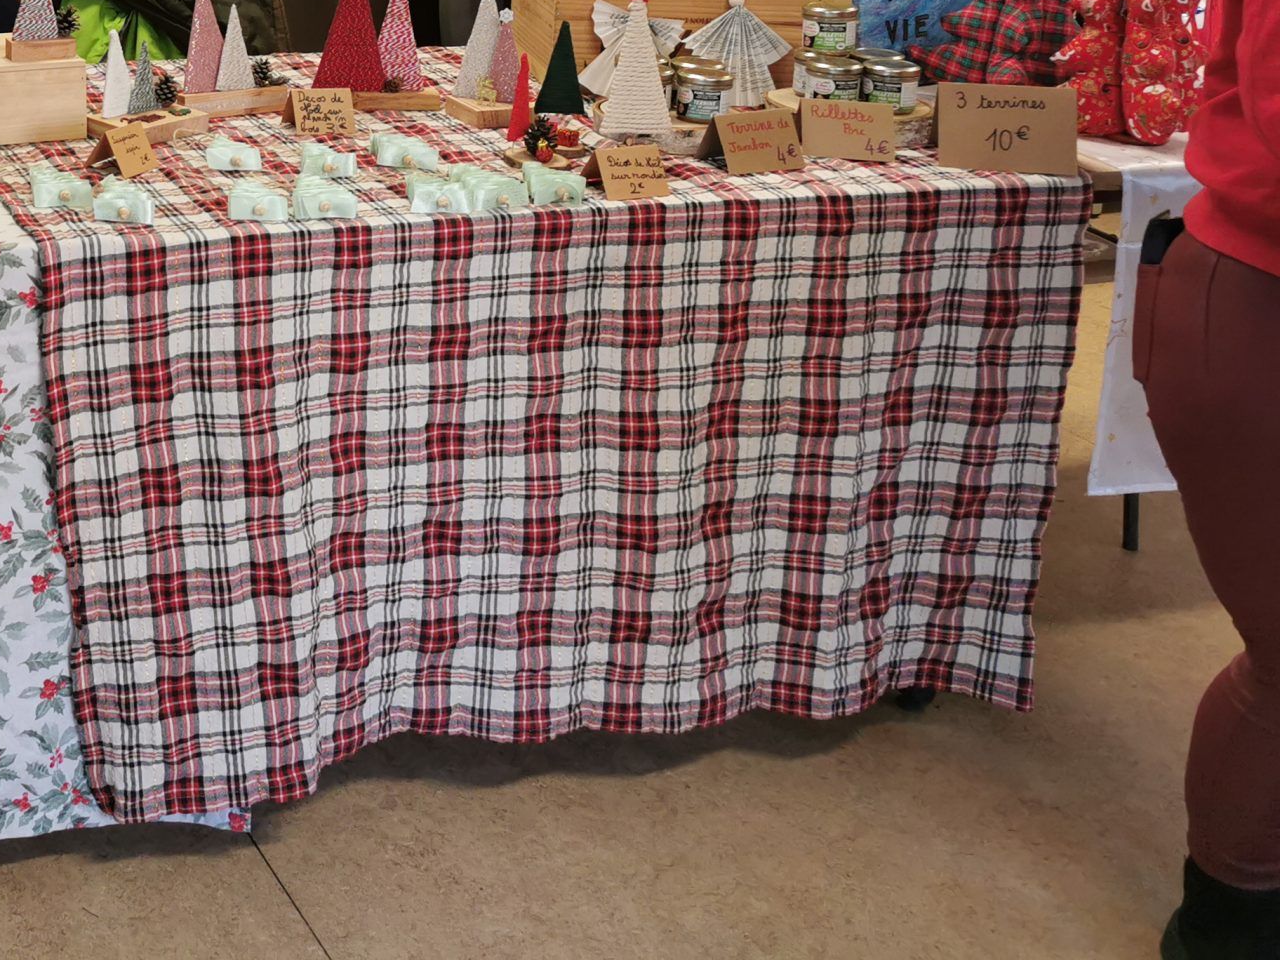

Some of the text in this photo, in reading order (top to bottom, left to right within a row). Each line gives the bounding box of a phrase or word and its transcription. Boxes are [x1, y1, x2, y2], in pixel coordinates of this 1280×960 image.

[885, 13, 929, 45] VIE
[331, 92, 344, 103] de
[956, 91, 1046, 110] 3 terrines
[811, 103, 874, 123] Rillettes
[726, 120, 774, 134] Terrine
[985, 125, 1030, 152] 10€
